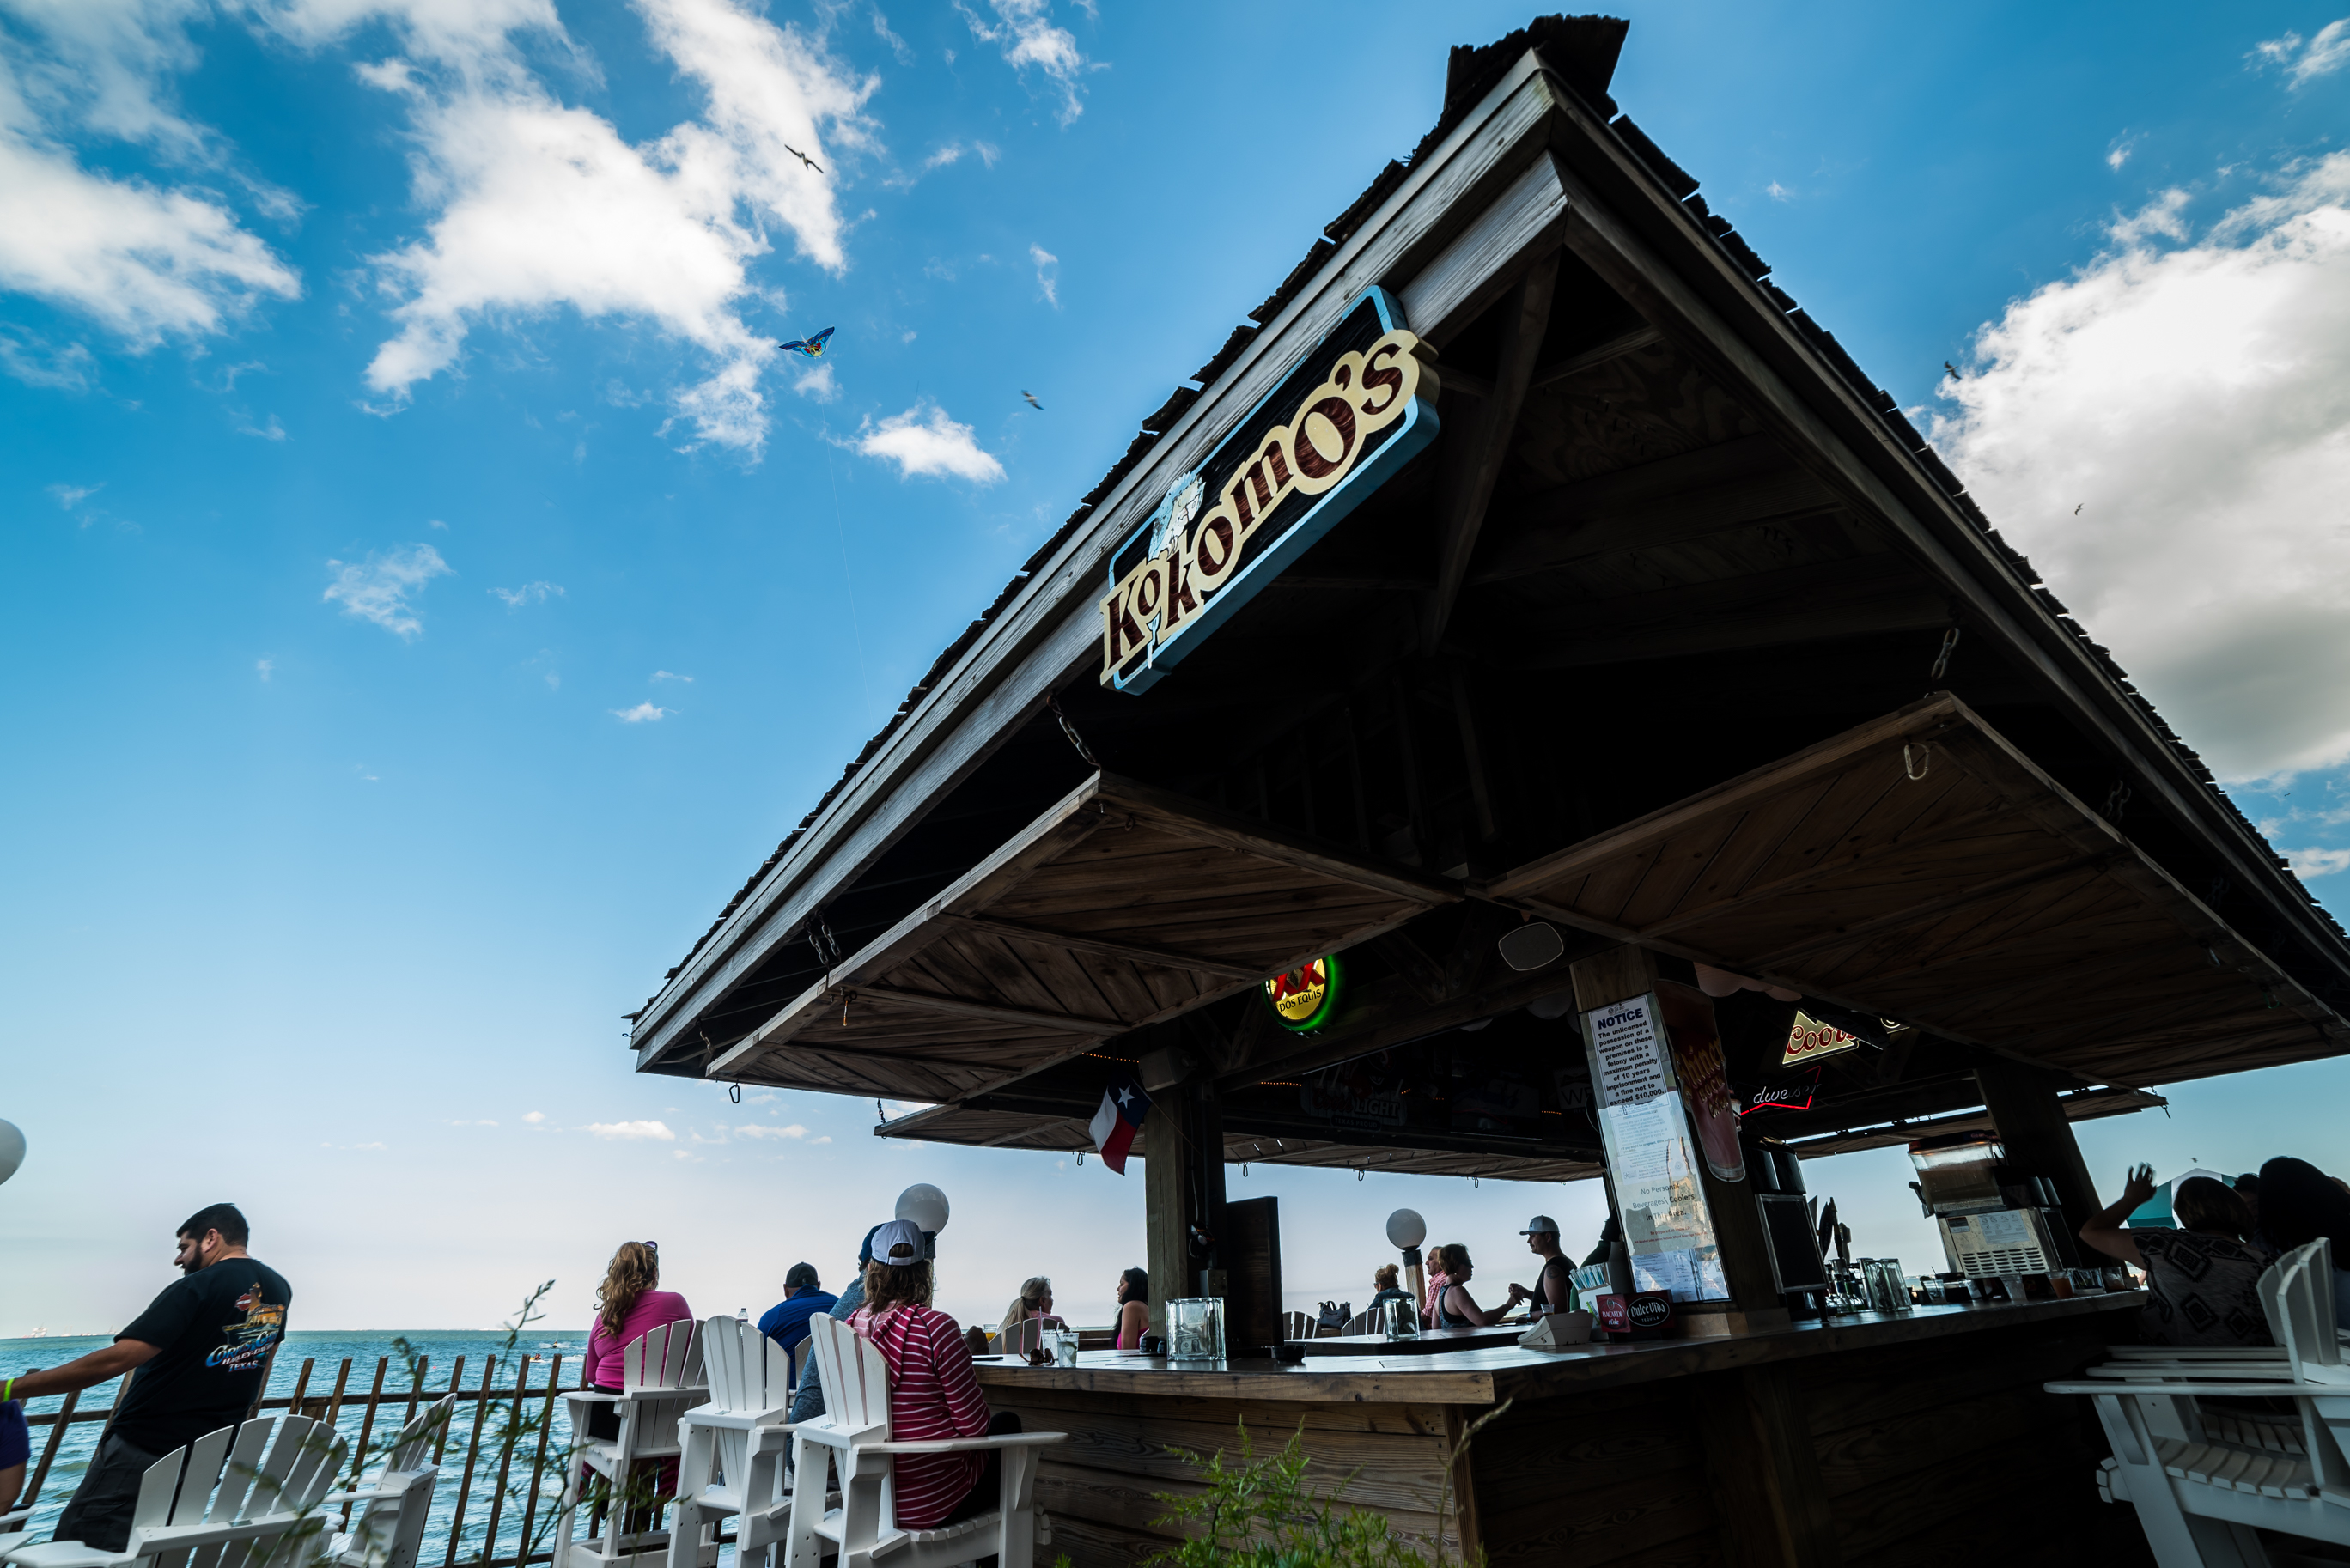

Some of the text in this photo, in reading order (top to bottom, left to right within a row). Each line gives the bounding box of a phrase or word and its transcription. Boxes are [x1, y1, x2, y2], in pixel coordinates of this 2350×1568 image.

[1279, 989, 1322, 1012] DOS EQUIS
[1598, 1008, 1643, 1030] NOTICE
[1612, 1020, 1647, 1035] unlicensed
[1598, 1033, 1635, 1047] possession
[1599, 1044, 1623, 1054] weapon
[1635, 1036, 1653, 1044] these
[1605, 1048, 1635, 1061] premises
[1603, 1058, 1658, 1076] maximum penalty
[1607, 1058, 1627, 1067] felony
[1632, 1068, 1651, 1078] years
[1606, 1076, 1647, 1091] imprisonment
[1610, 1088, 1665, 1106] exceed $10,000.
[1355, 1099, 1400, 1116] LIGHT
[1335, 1117, 1378, 1128] TEXAS PROUD
[1651, 1182, 1680, 1193] Personal
[1669, 1194, 1696, 1203] Coolers
[1630, 1301, 1666, 1317] Dulce Vida
[228, 1360, 259, 1372] TEXAS
